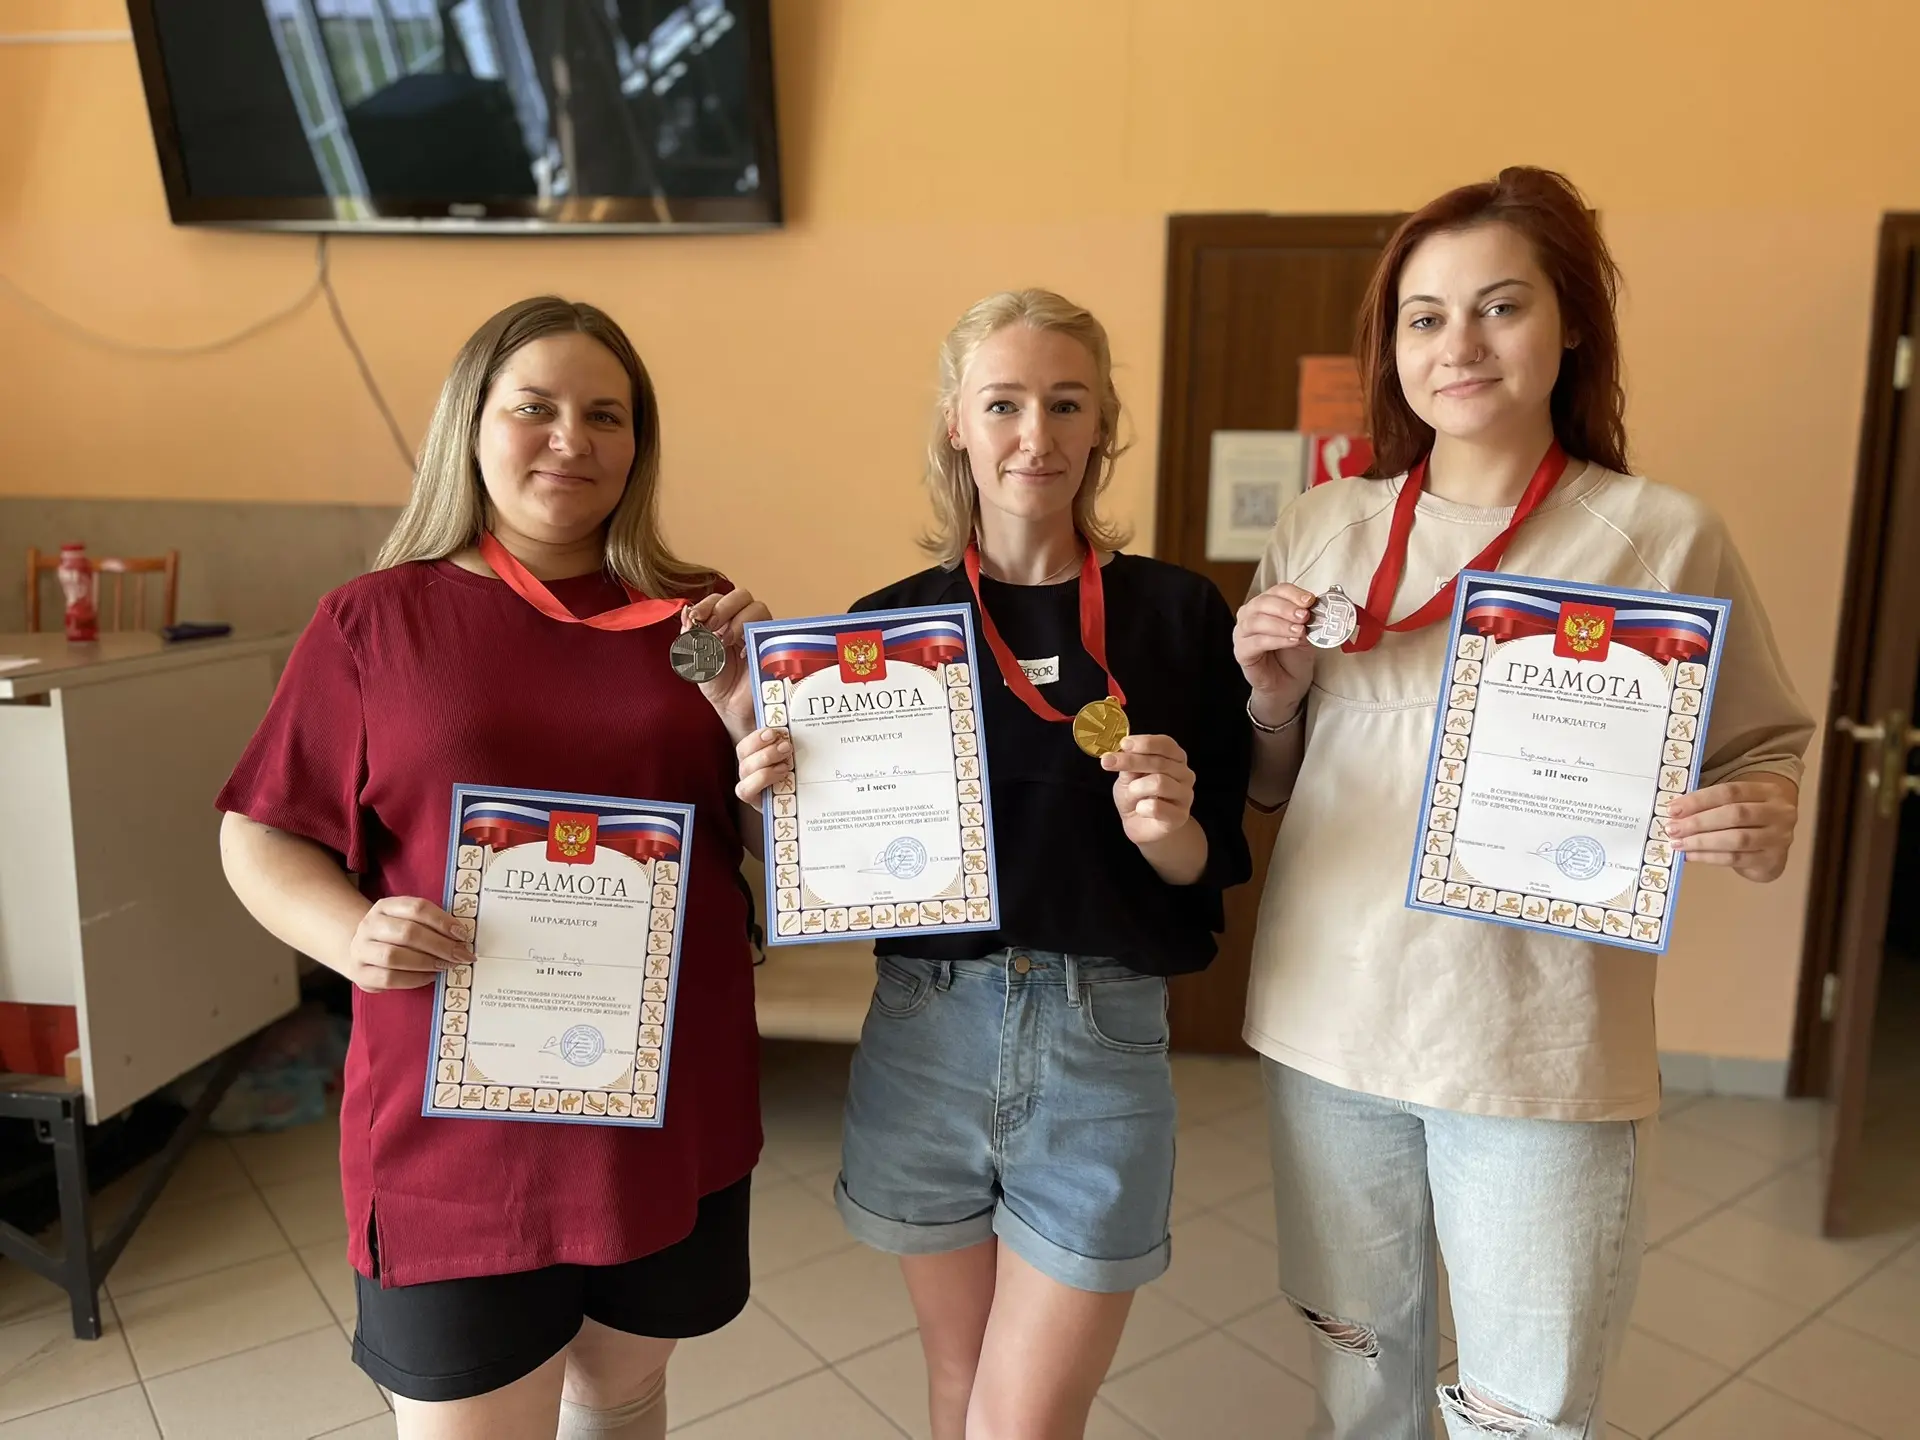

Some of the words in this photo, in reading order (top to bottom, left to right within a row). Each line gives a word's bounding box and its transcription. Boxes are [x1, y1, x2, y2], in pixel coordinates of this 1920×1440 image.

[1020, 665, 1054, 680] RESOR
[1505, 662, 1645, 700] ГРАМОТА
[807, 687, 925, 715] ГРАМОТА
[1531, 712, 1606, 730] НАГРАЖДАЕТСЯ
[840, 731, 903, 744] НАГРАЖДАЕТСЯ
[1544, 768, 1557, 777] III
[1559, 773, 1588, 782] место
[1593, 803, 1622, 813] РАМКАХ
[504, 868, 629, 897] ГРАМОТА
[529, 915, 597, 927] НАГРАЖДАЕТСЯ
